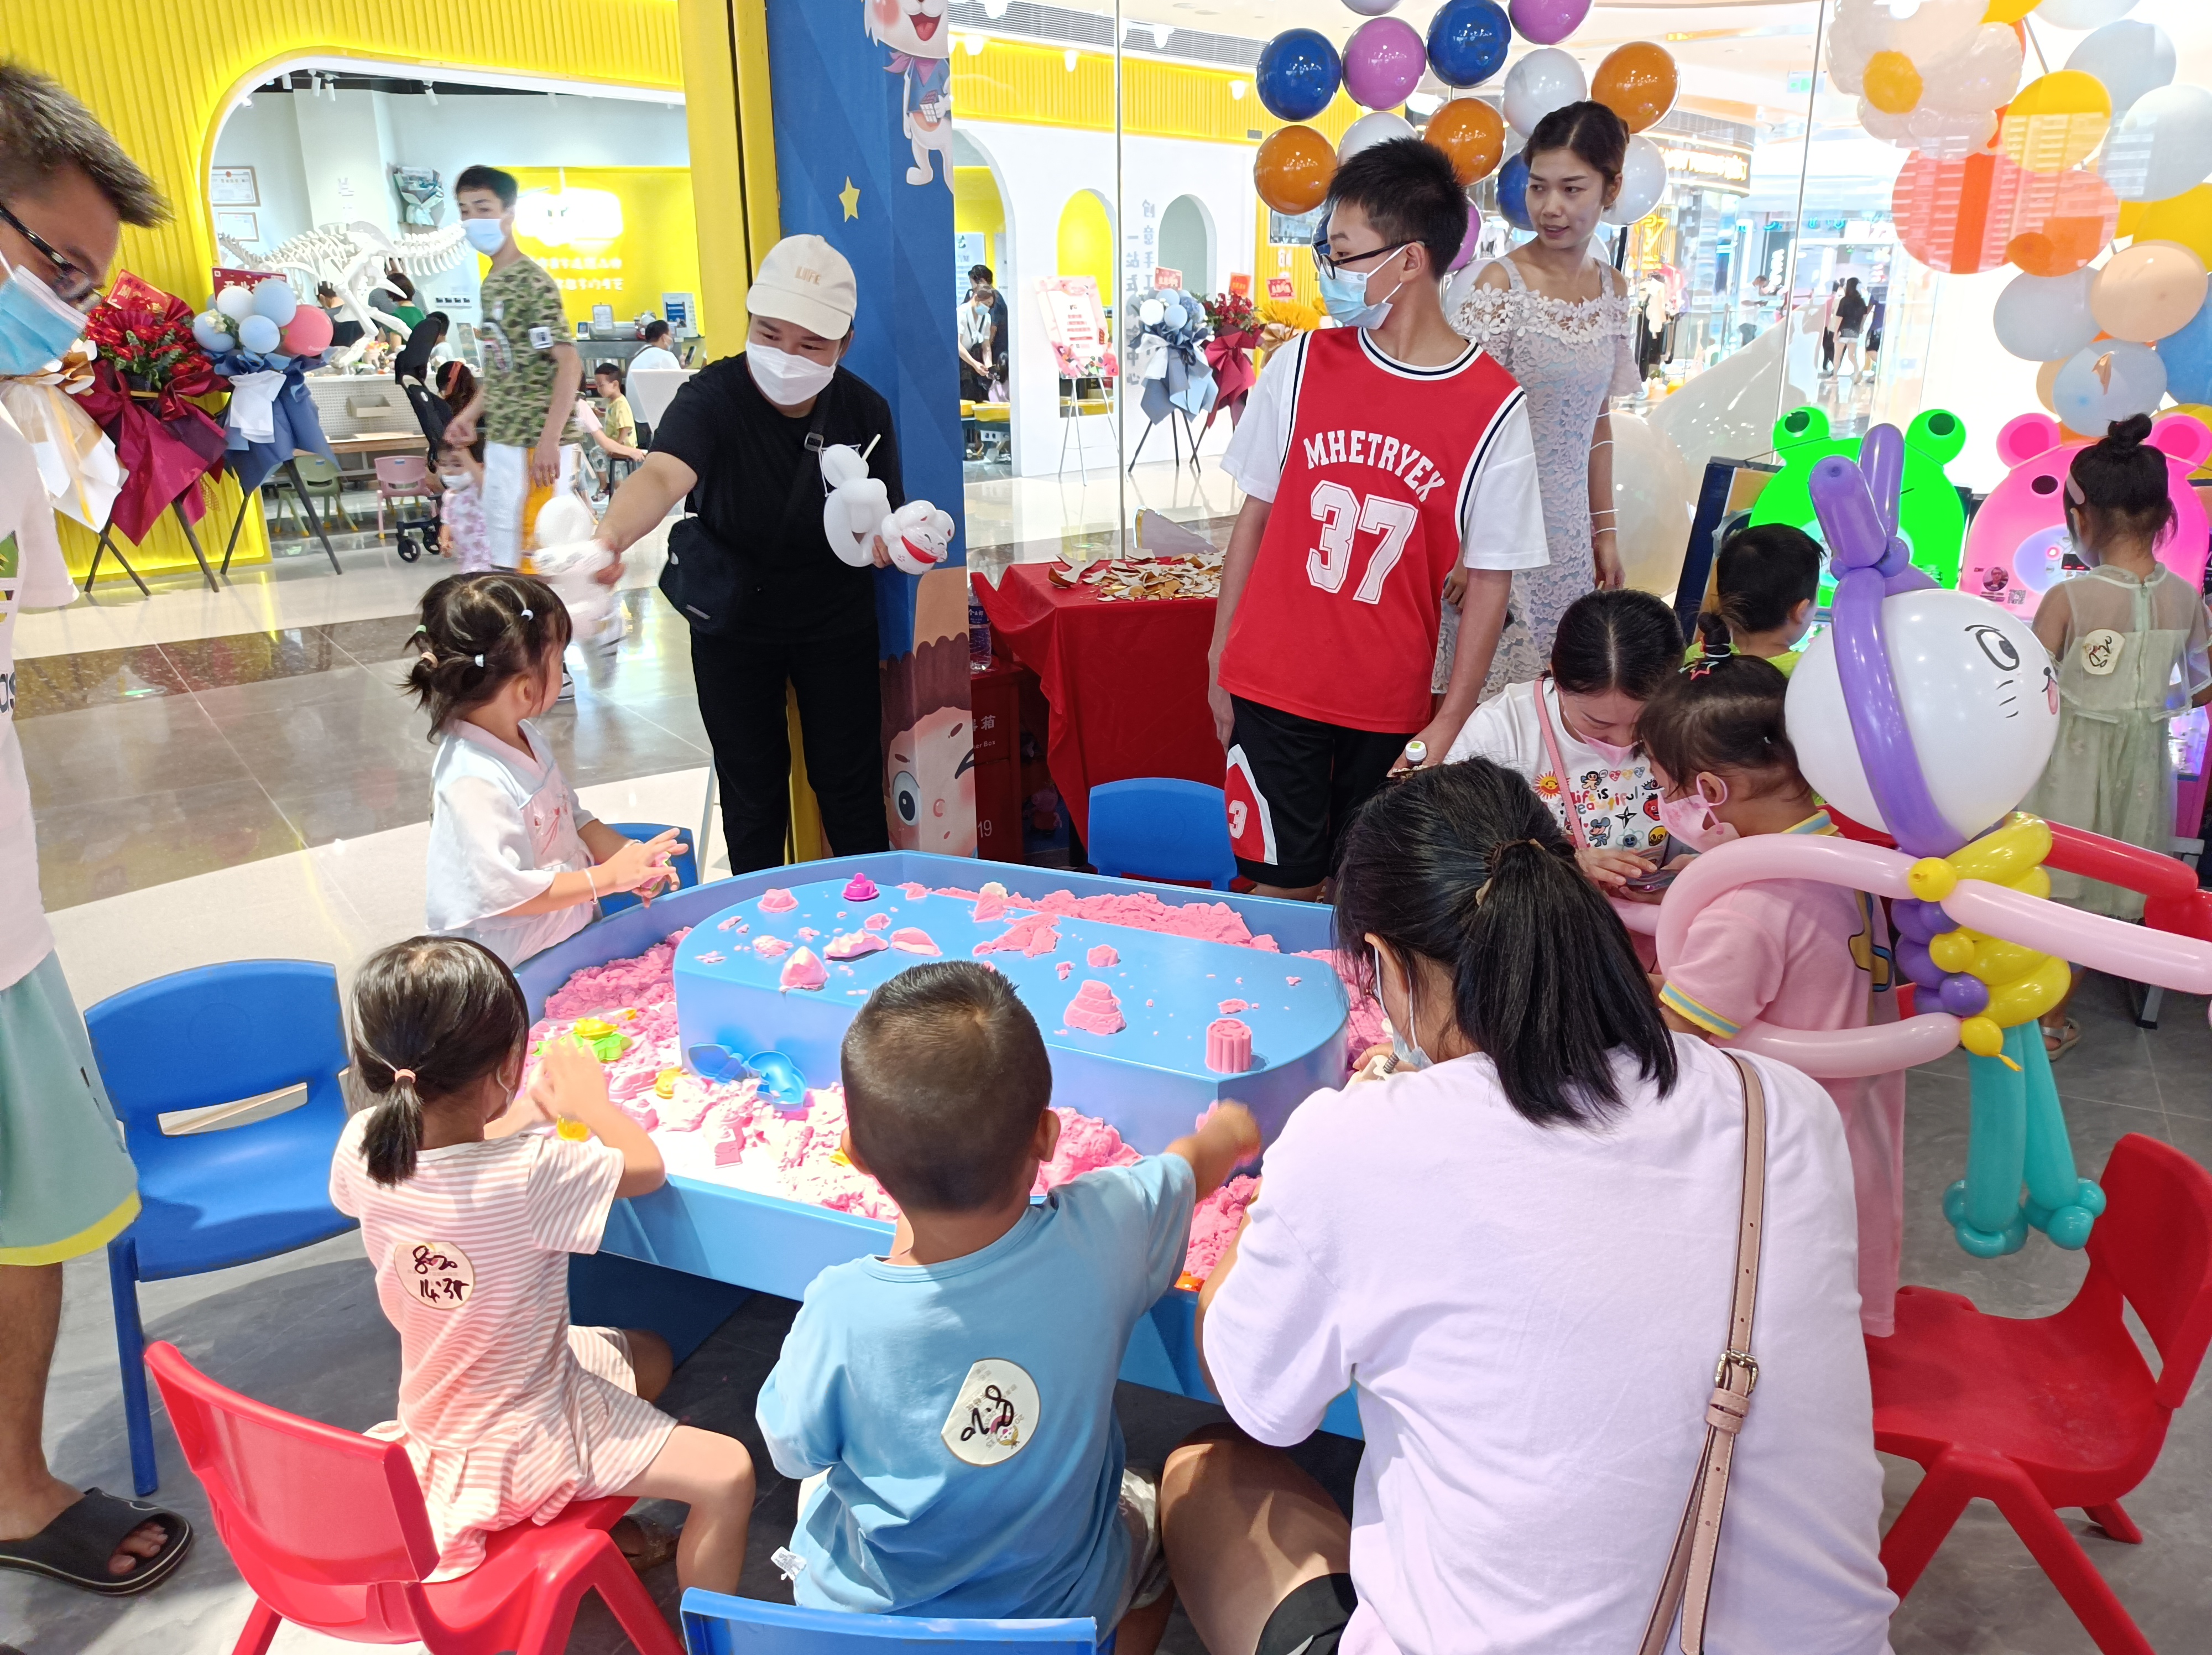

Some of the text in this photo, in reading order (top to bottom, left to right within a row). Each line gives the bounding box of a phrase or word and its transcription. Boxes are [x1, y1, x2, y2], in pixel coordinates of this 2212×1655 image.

[1303, 430, 1445, 502] MHETRYEX
[1306, 480, 1418, 605] 37
[1597, 788, 1609, 800] is
[978, 819, 992, 838] 19
